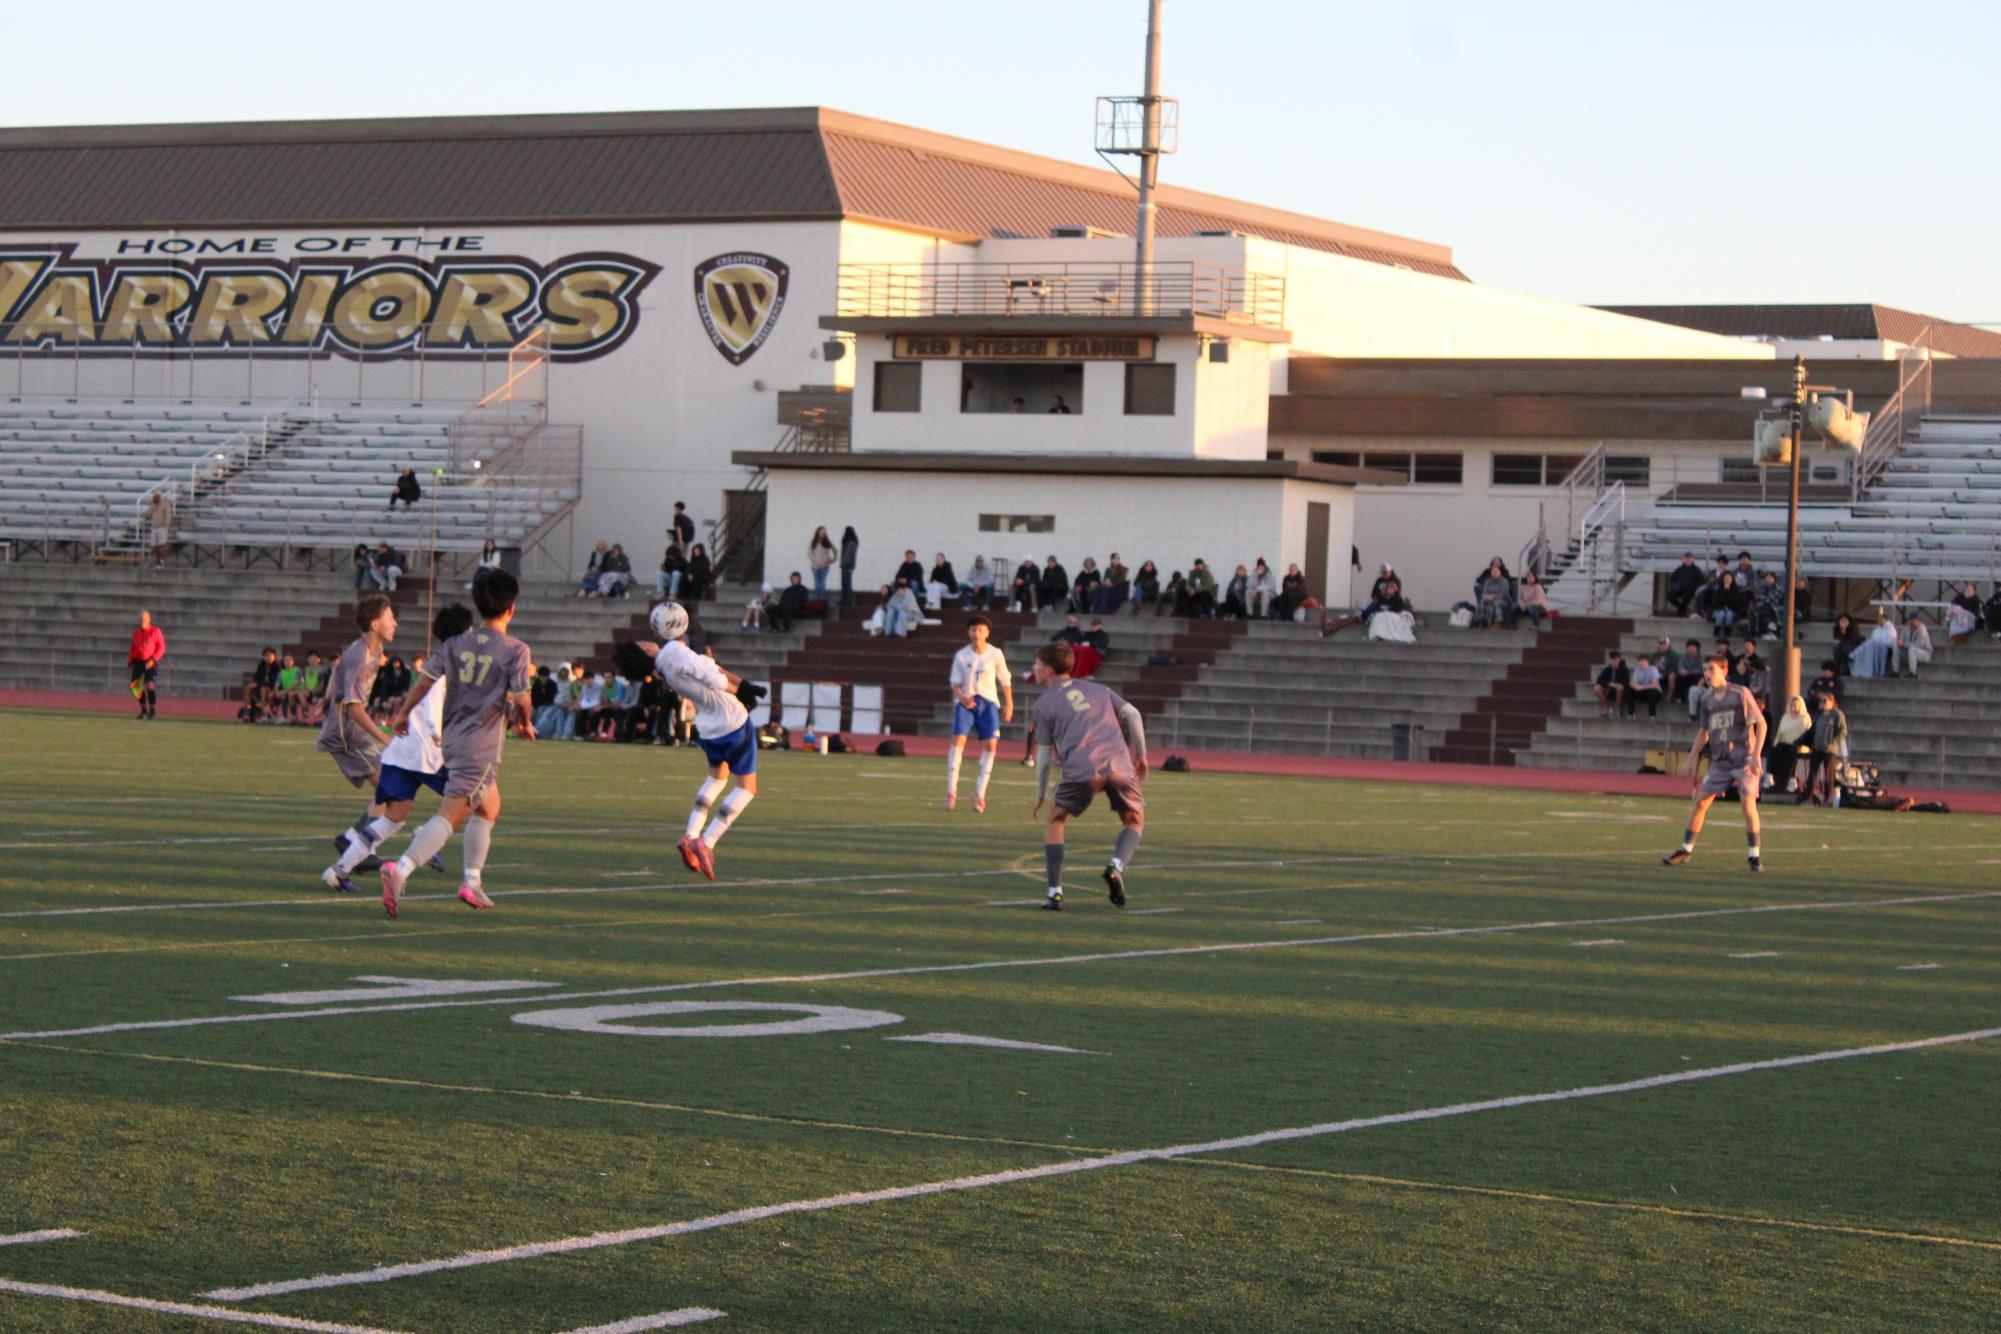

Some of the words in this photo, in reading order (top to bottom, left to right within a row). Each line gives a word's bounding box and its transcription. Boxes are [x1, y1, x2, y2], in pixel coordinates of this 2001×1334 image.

[116, 237, 279, 254] HOME
[294, 237, 373, 253] OF
[381, 235, 486, 252] THE
[716, 254, 767, 266] CREATIVITY
[906, 338, 951, 356] FRED
[959, 338, 1047, 356] PETERSEN
[1056, 338, 1140, 356] STADIUM
[459, 650, 494, 687] 37
[1066, 689, 1091, 713] 2
[1710, 710, 1736, 730] WEST
